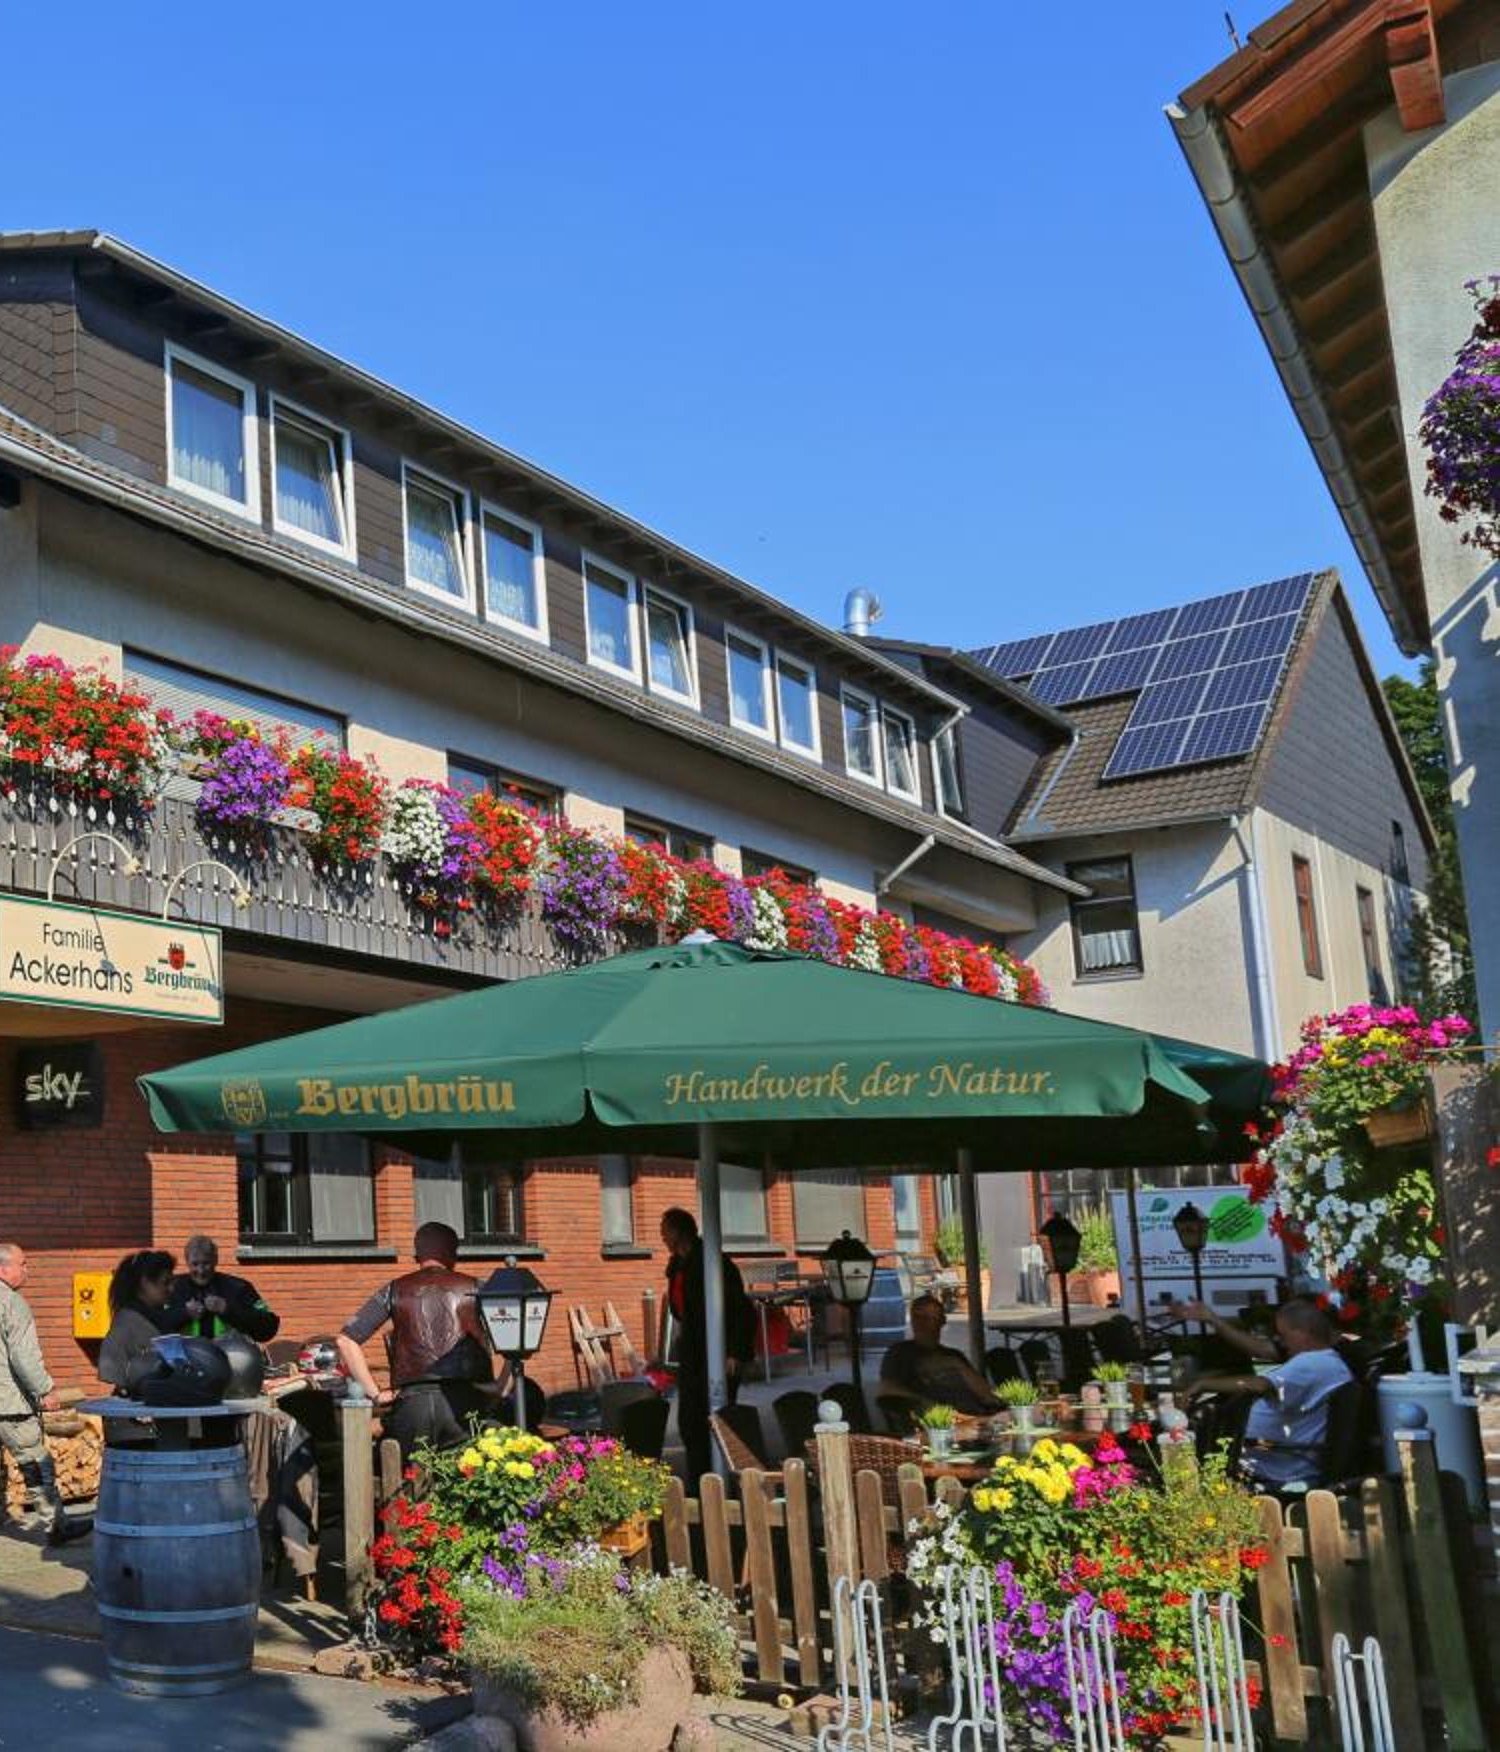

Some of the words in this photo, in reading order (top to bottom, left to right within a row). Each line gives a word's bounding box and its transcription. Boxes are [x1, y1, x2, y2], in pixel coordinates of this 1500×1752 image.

[43, 922, 105, 952] Familie
[9, 951, 133, 994] Ackerhans
[25, 1063, 83, 1110] sky
[296, 1075, 516, 1119] Bergbräu
[665, 1062, 861, 1105] Handwerk
[861, 1060, 921, 1097] der
[927, 1063, 1057, 1097] Natur.
